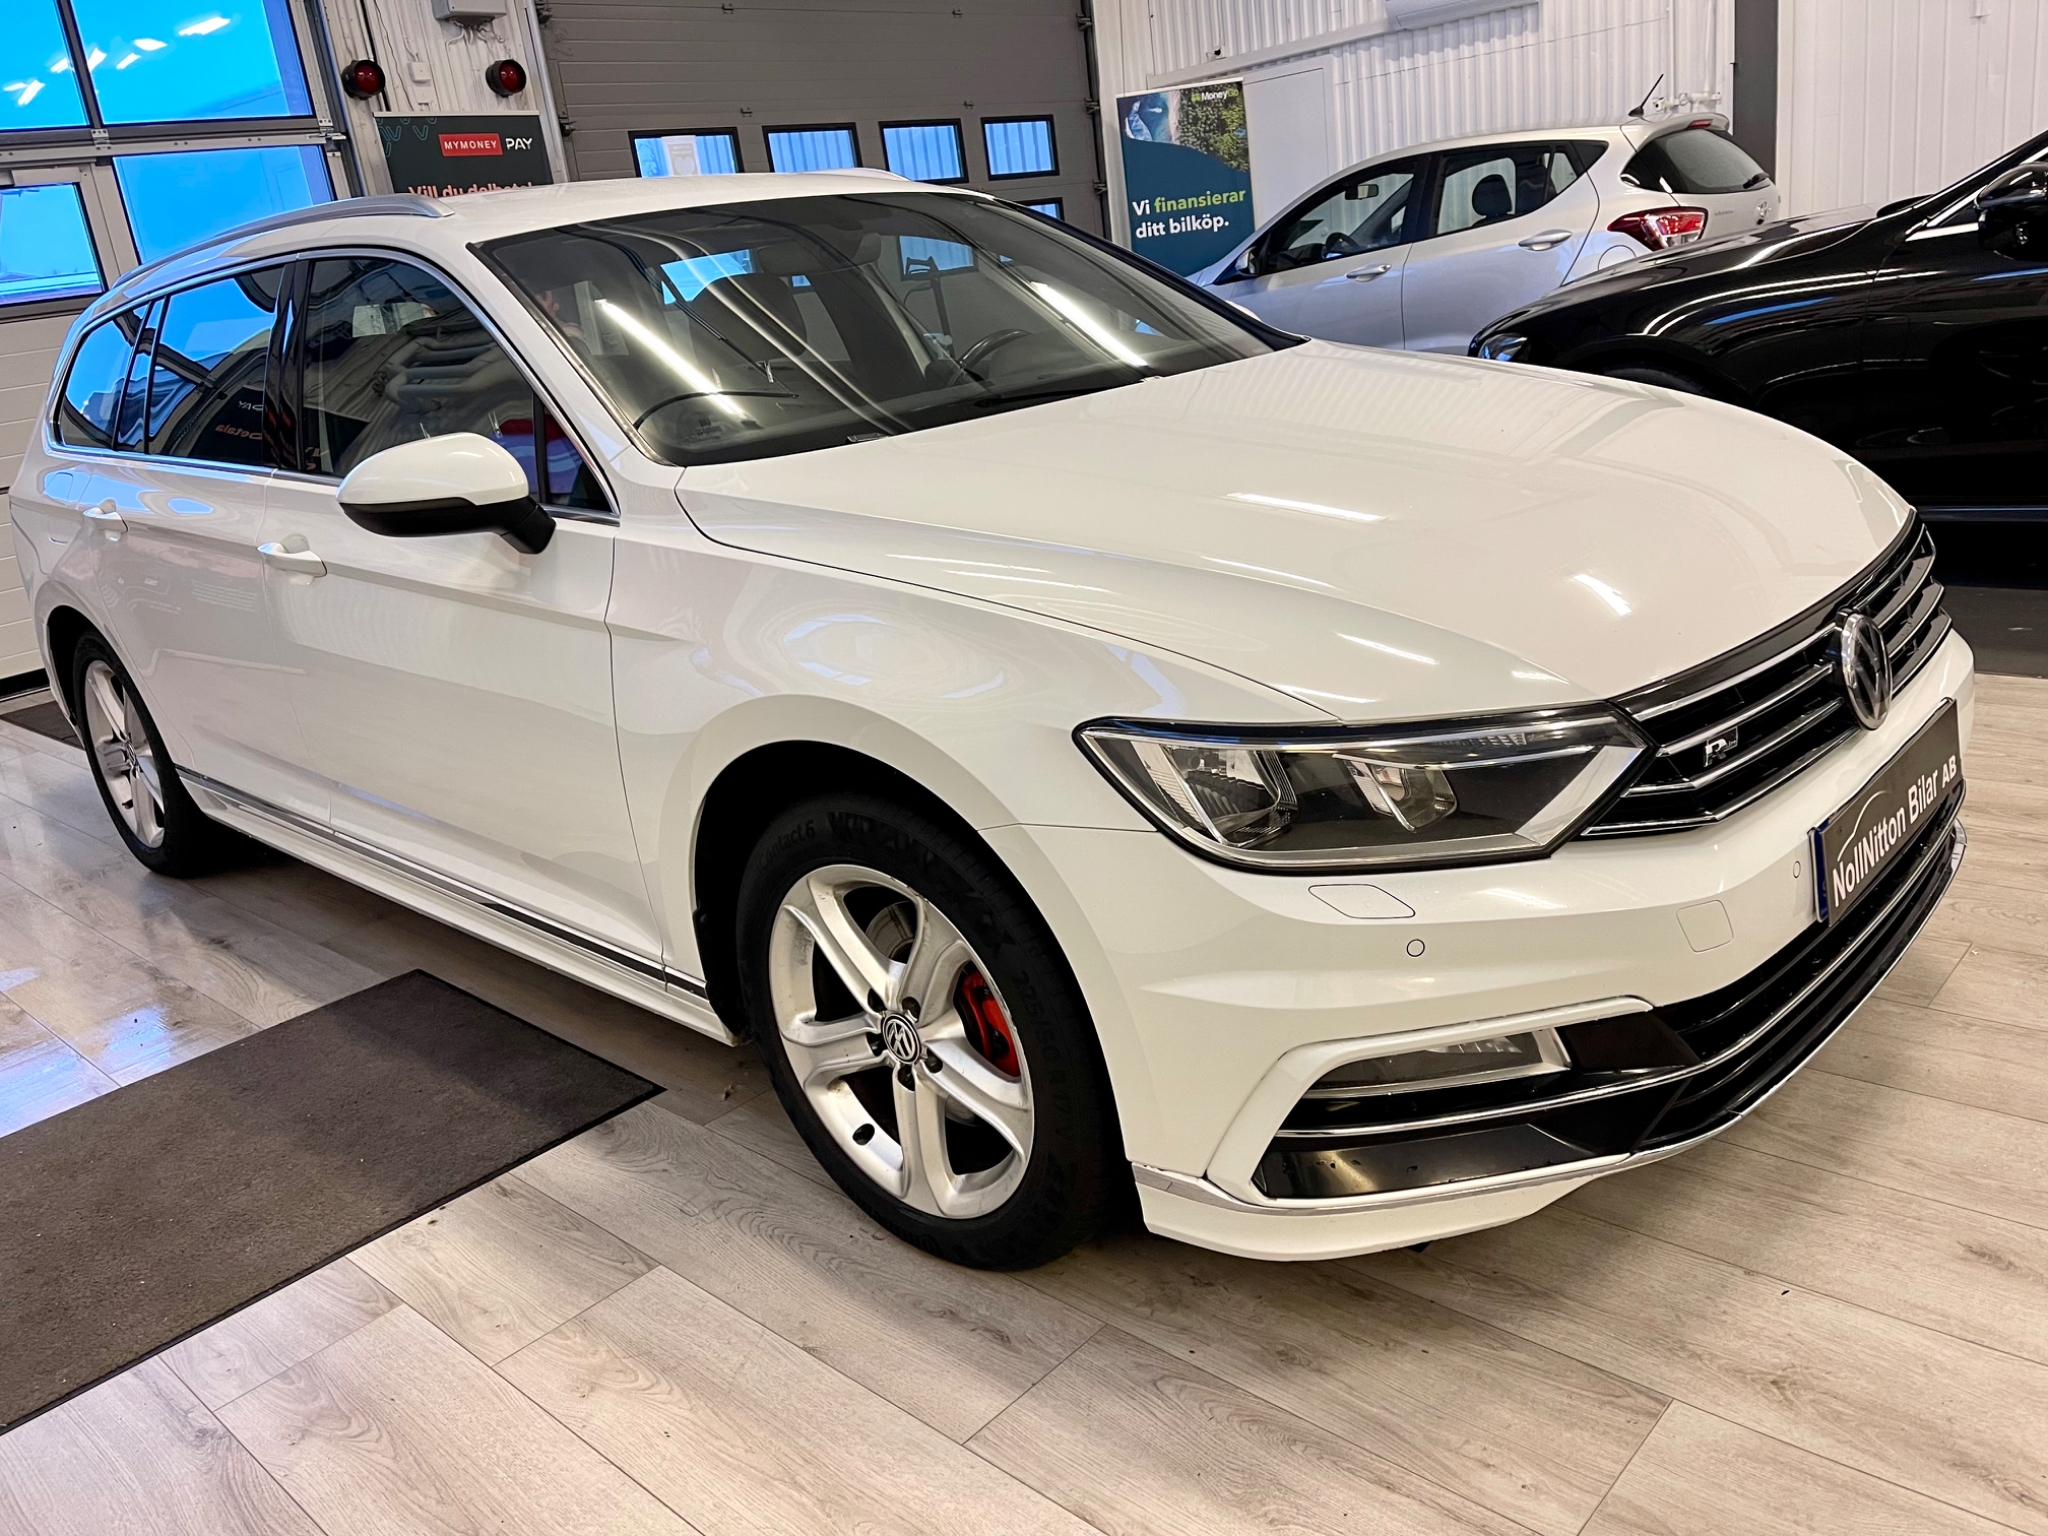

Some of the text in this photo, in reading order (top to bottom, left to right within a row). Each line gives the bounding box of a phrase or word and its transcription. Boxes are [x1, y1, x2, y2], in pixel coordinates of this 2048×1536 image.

[444, 137, 533, 150] MYMONEY PAY
[442, 185, 463, 197] du
[1132, 189, 1246, 216] Vi finansierar
[1135, 214, 1229, 239] ditt bilköp.
[1832, 754, 1958, 908] NollNitton Bilar AB
